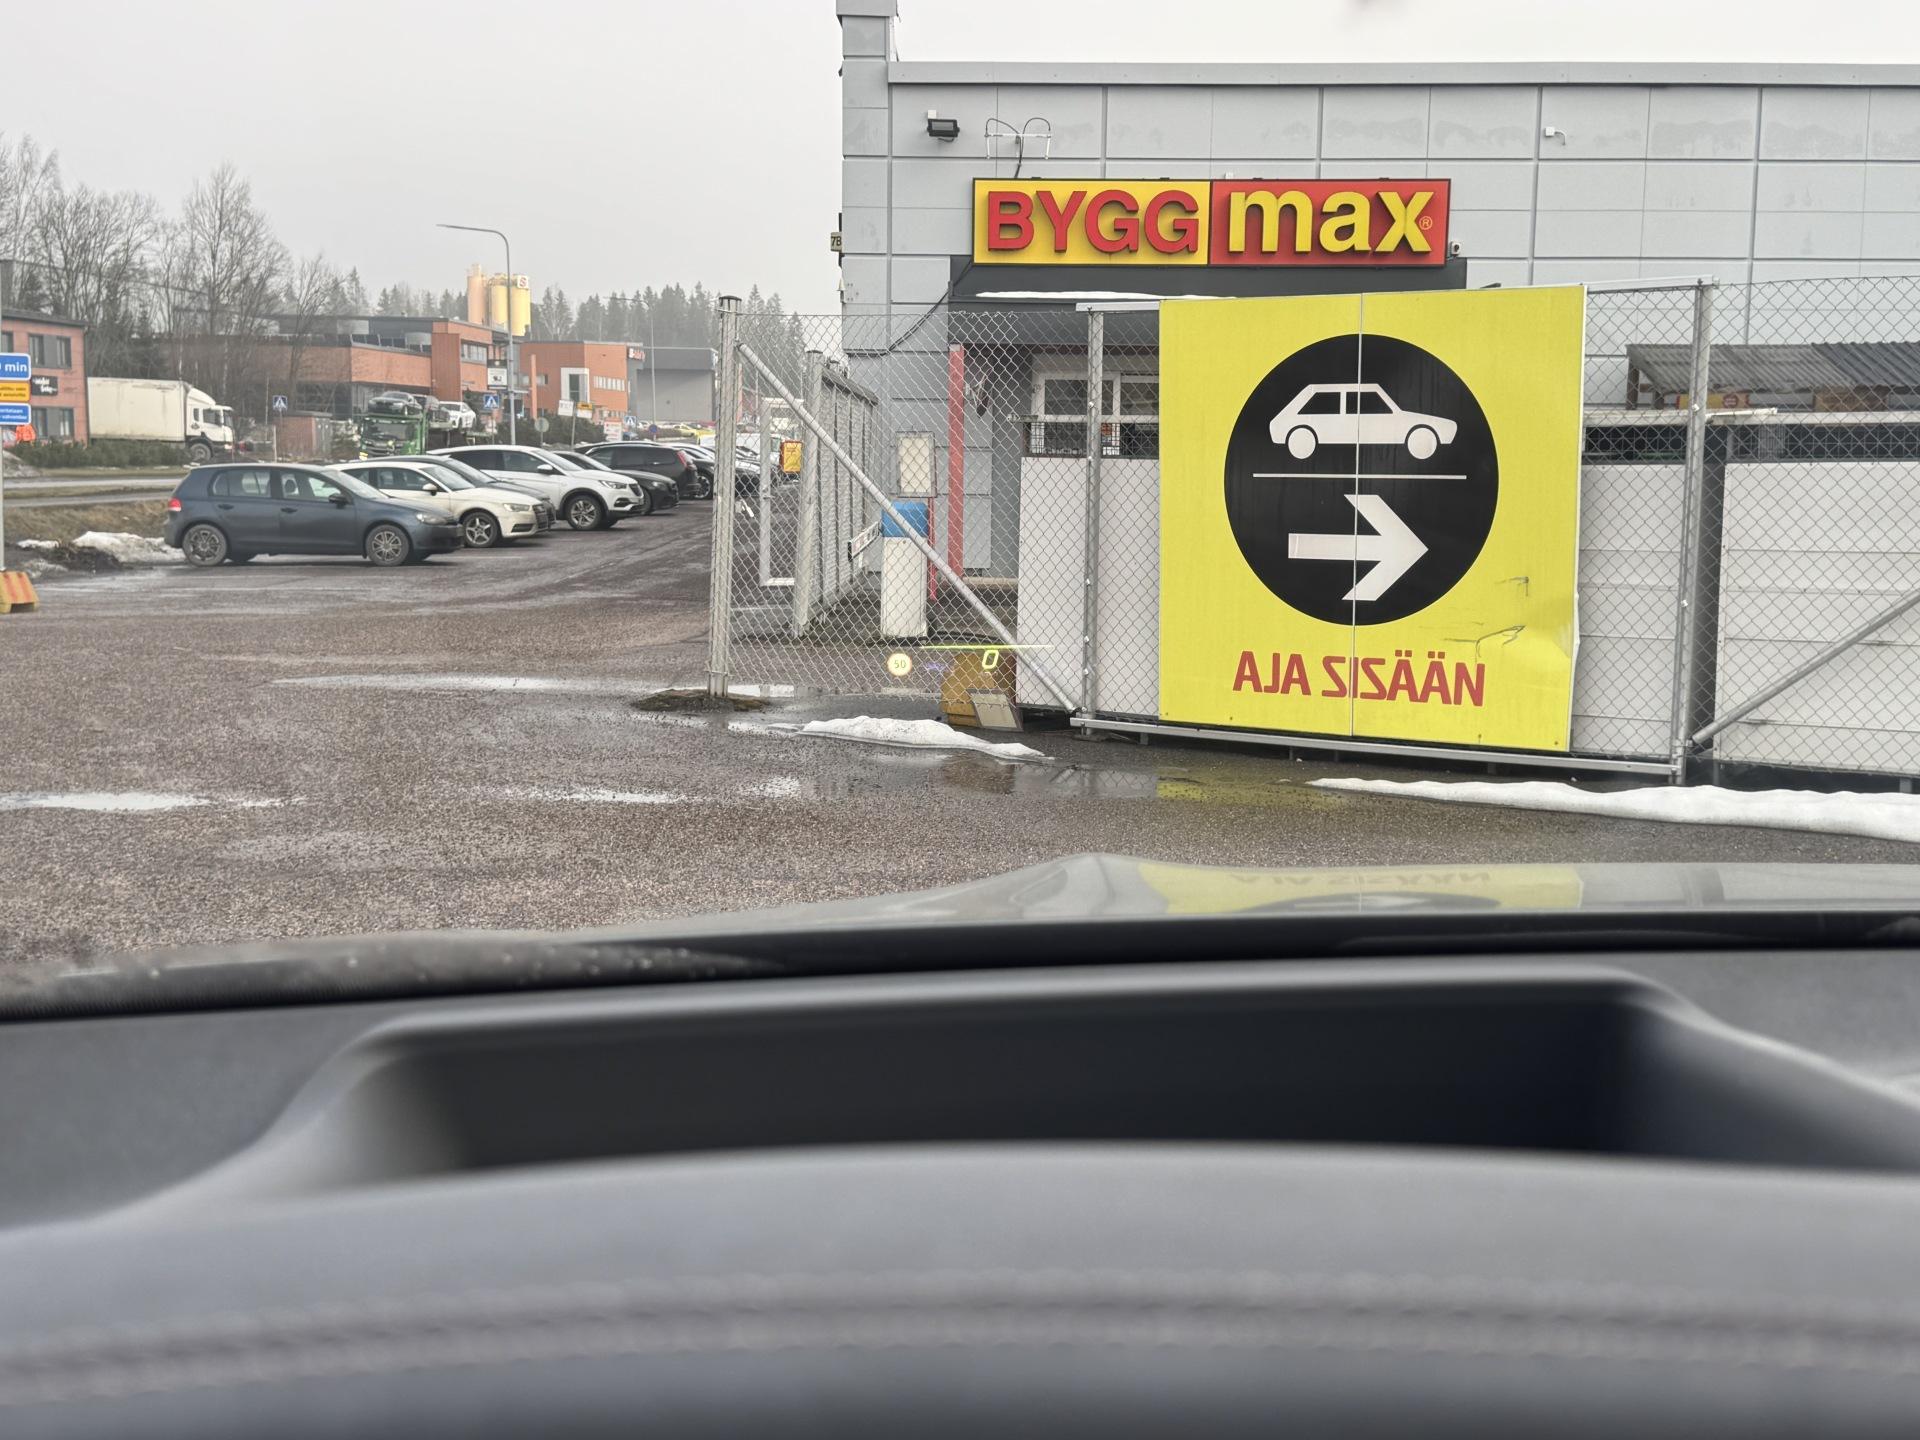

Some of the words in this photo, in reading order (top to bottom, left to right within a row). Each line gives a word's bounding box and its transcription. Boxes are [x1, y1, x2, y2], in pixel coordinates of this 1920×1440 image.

[987, 189, 1200, 254] BYGG
[5, 361, 27, 372] min
[1232, 650, 1312, 696] AJA
[1321, 649, 1486, 707] SISÄÄN
